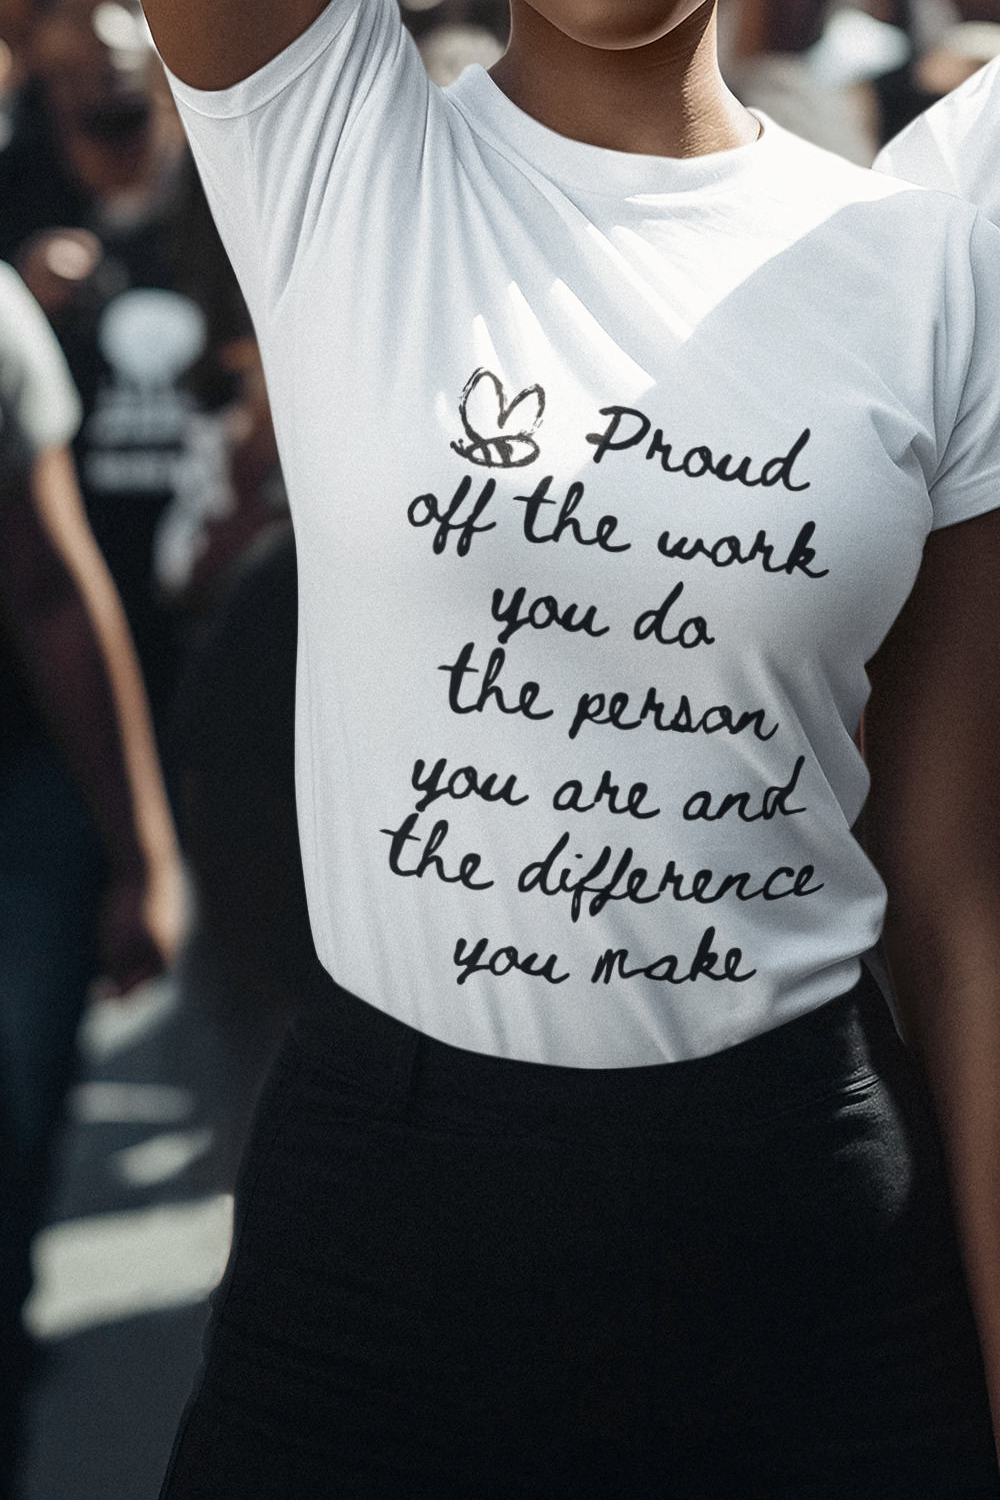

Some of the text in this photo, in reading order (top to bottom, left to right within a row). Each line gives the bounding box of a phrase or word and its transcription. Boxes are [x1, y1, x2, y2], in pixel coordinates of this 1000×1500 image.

[585, 405, 811, 492] Proud
[407, 475, 830, 579] off the work
[490, 580, 716, 649] you do
[437, 641, 780, 742] the person
[411, 754, 808, 823] you are and
[379, 812, 825, 924] the difference
[453, 925, 758, 986] you make
